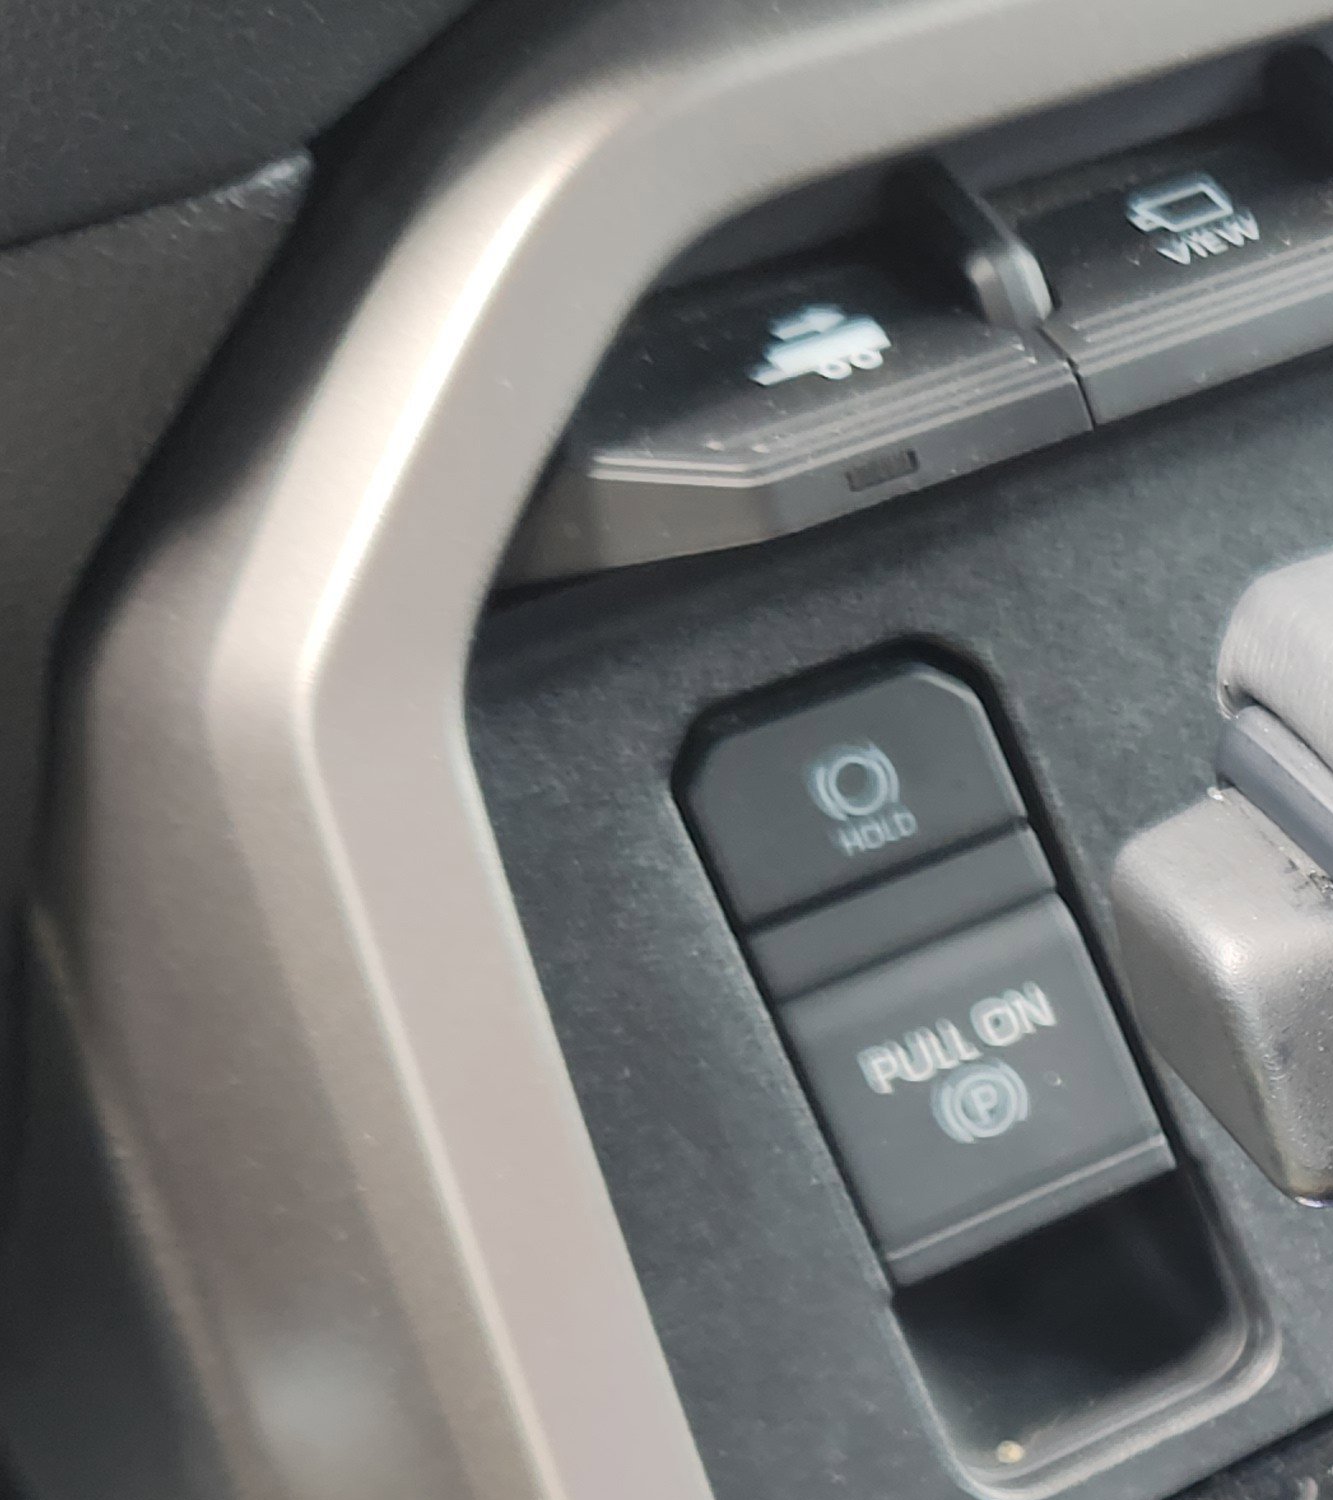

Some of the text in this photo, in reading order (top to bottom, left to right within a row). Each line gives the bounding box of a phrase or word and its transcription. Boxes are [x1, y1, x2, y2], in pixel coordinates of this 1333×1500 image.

[1154, 207, 1260, 265] VIEW
[832, 805, 918, 857] HOLD
[857, 981, 1057, 1094] PULL ON
